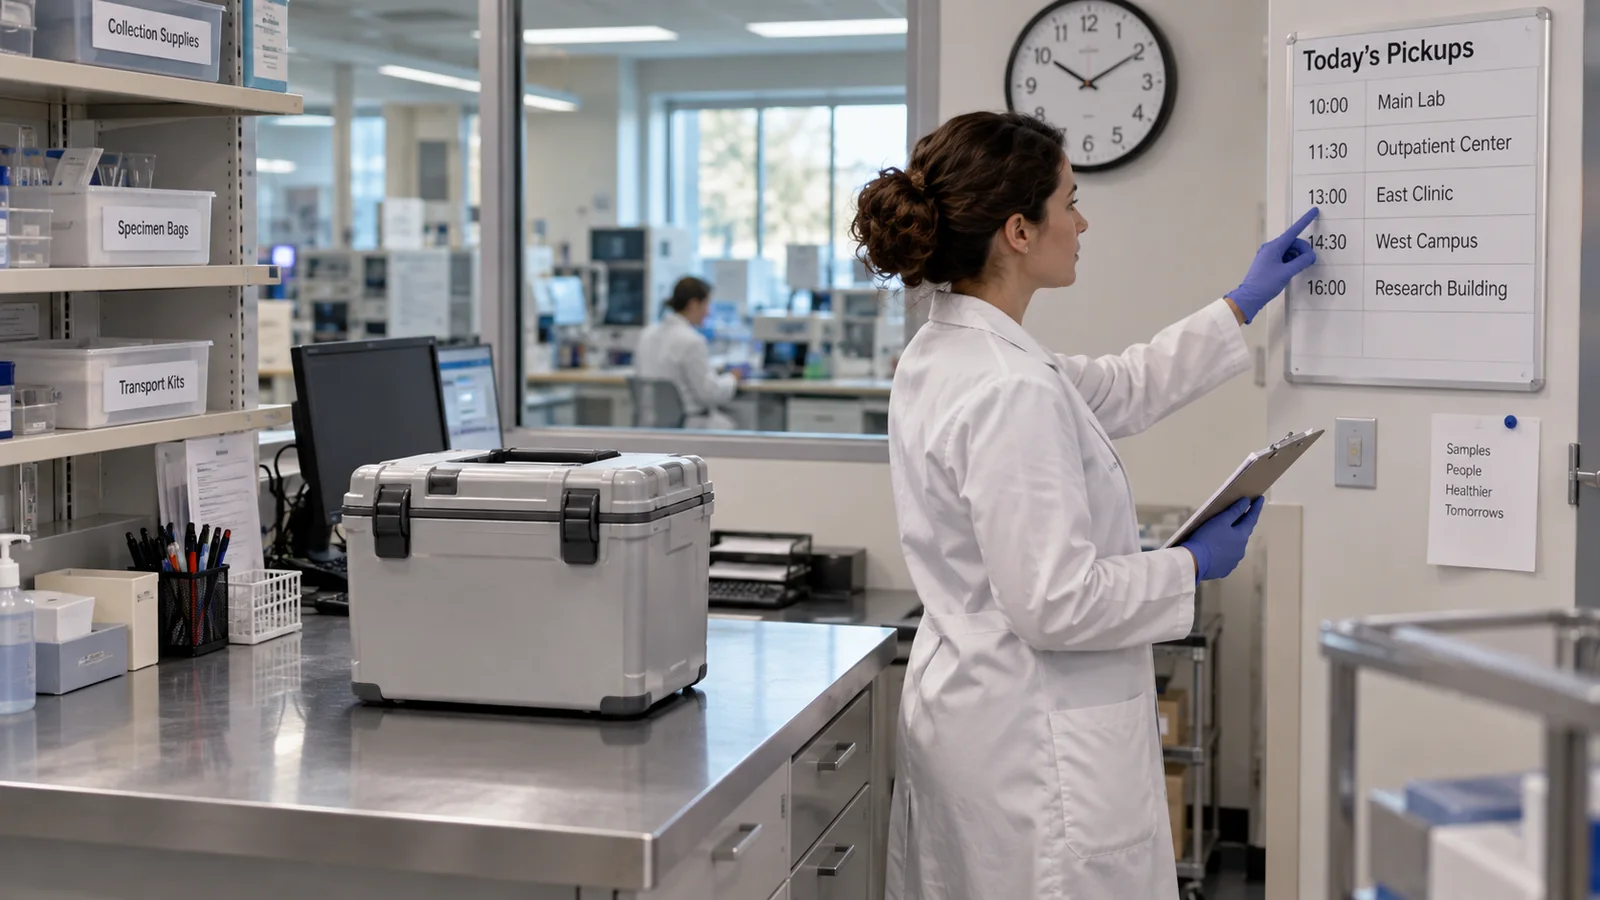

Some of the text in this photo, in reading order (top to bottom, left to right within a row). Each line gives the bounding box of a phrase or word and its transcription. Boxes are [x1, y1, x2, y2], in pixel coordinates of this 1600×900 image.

[1081, 14, 1098, 32] 12
[1115, 22, 1121, 39] 1
[108, 18, 199, 48] Collection Supplies
[1055, 24, 1068, 42] 11
[1034, 47, 1051, 65] 10
[1132, 43, 1145, 61] 2
[1388, 39, 1474, 65] Pickups
[1025, 77, 1037, 95] 9
[1142, 73, 1153, 91] 3
[1310, 90, 1446, 114] 10:00 Main Lab
[1132, 104, 1144, 121] 4
[1082, 135, 1094, 153] 6
[1112, 126, 1123, 144] 5
[1309, 136, 1512, 159] 11:30 Outpatient Center
[1309, 185, 1453, 204] 13:00 East Clinic
[118, 220, 190, 239] Specimen Bags
[1308, 233, 1478, 252] 14:30 West Campus
[1307, 279, 1507, 301] 16:00 Research Building
[119, 375, 185, 395] Transport Kits
[1447, 442, 1491, 458] Samples
[1447, 463, 1482, 479] People
[1446, 484, 1492, 497] Healthier
[1445, 504, 1504, 519] Tomorrows
